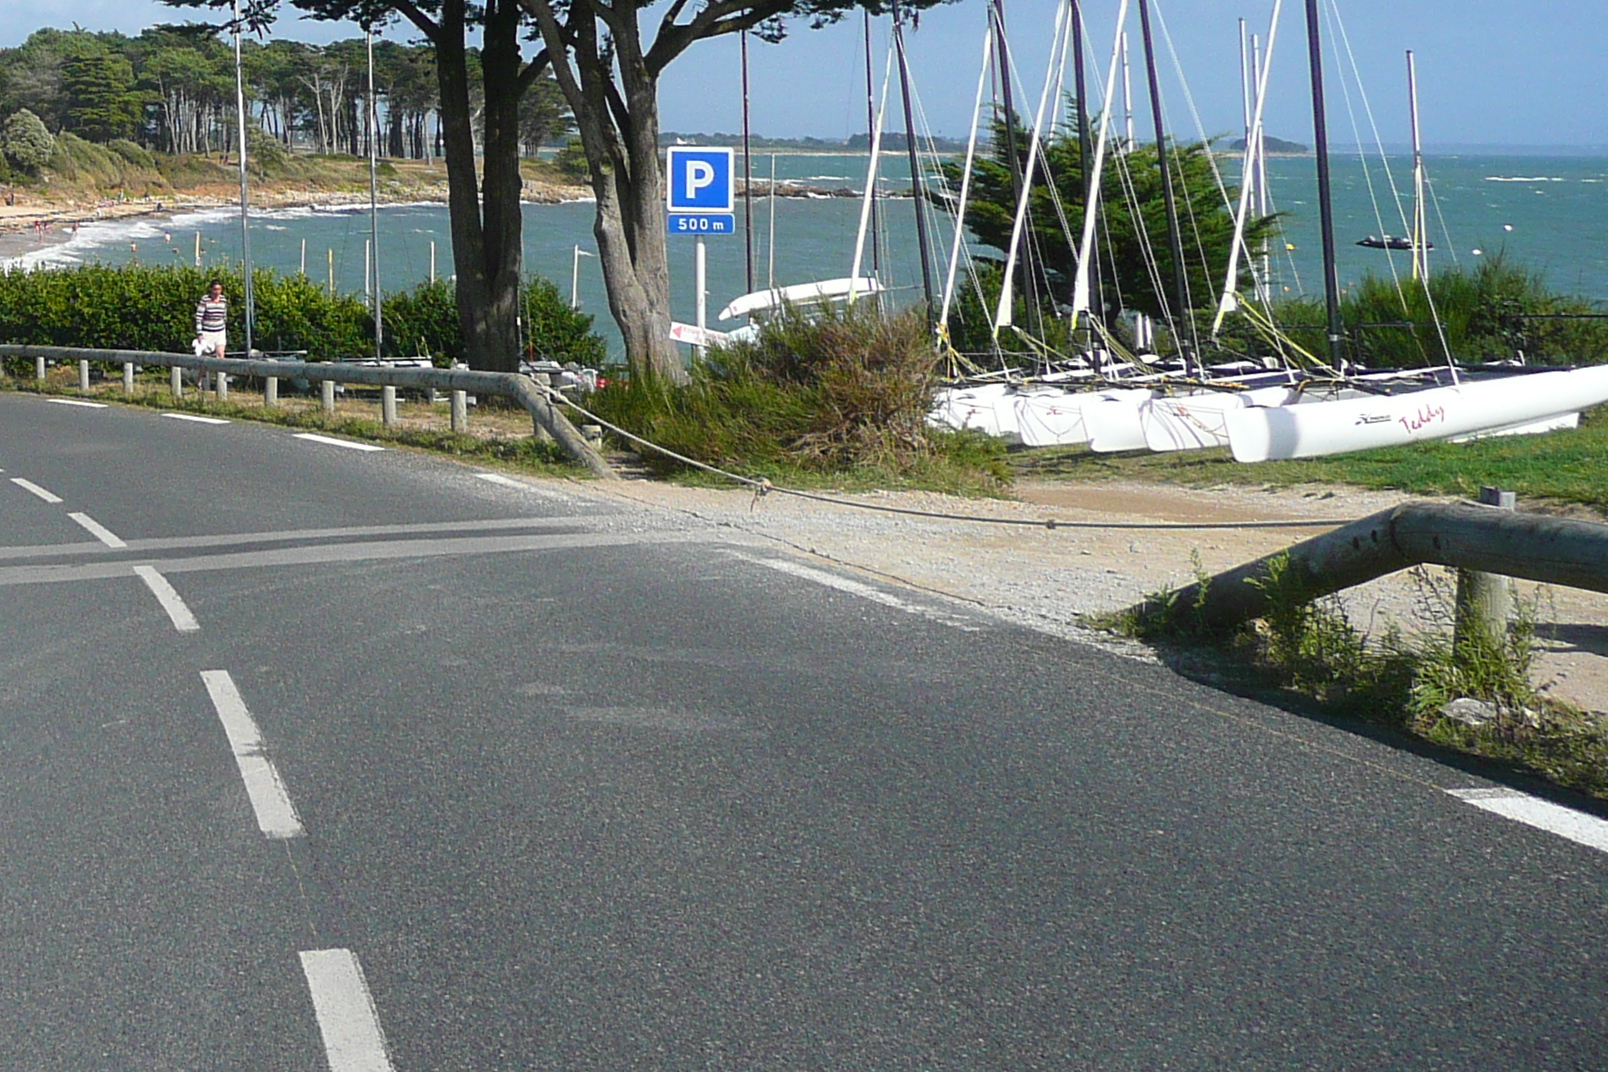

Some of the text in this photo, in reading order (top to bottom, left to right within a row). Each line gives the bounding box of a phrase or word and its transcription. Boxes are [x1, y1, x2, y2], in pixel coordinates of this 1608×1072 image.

[685, 160, 715, 199] P
[678, 218, 724, 231] 500 m
